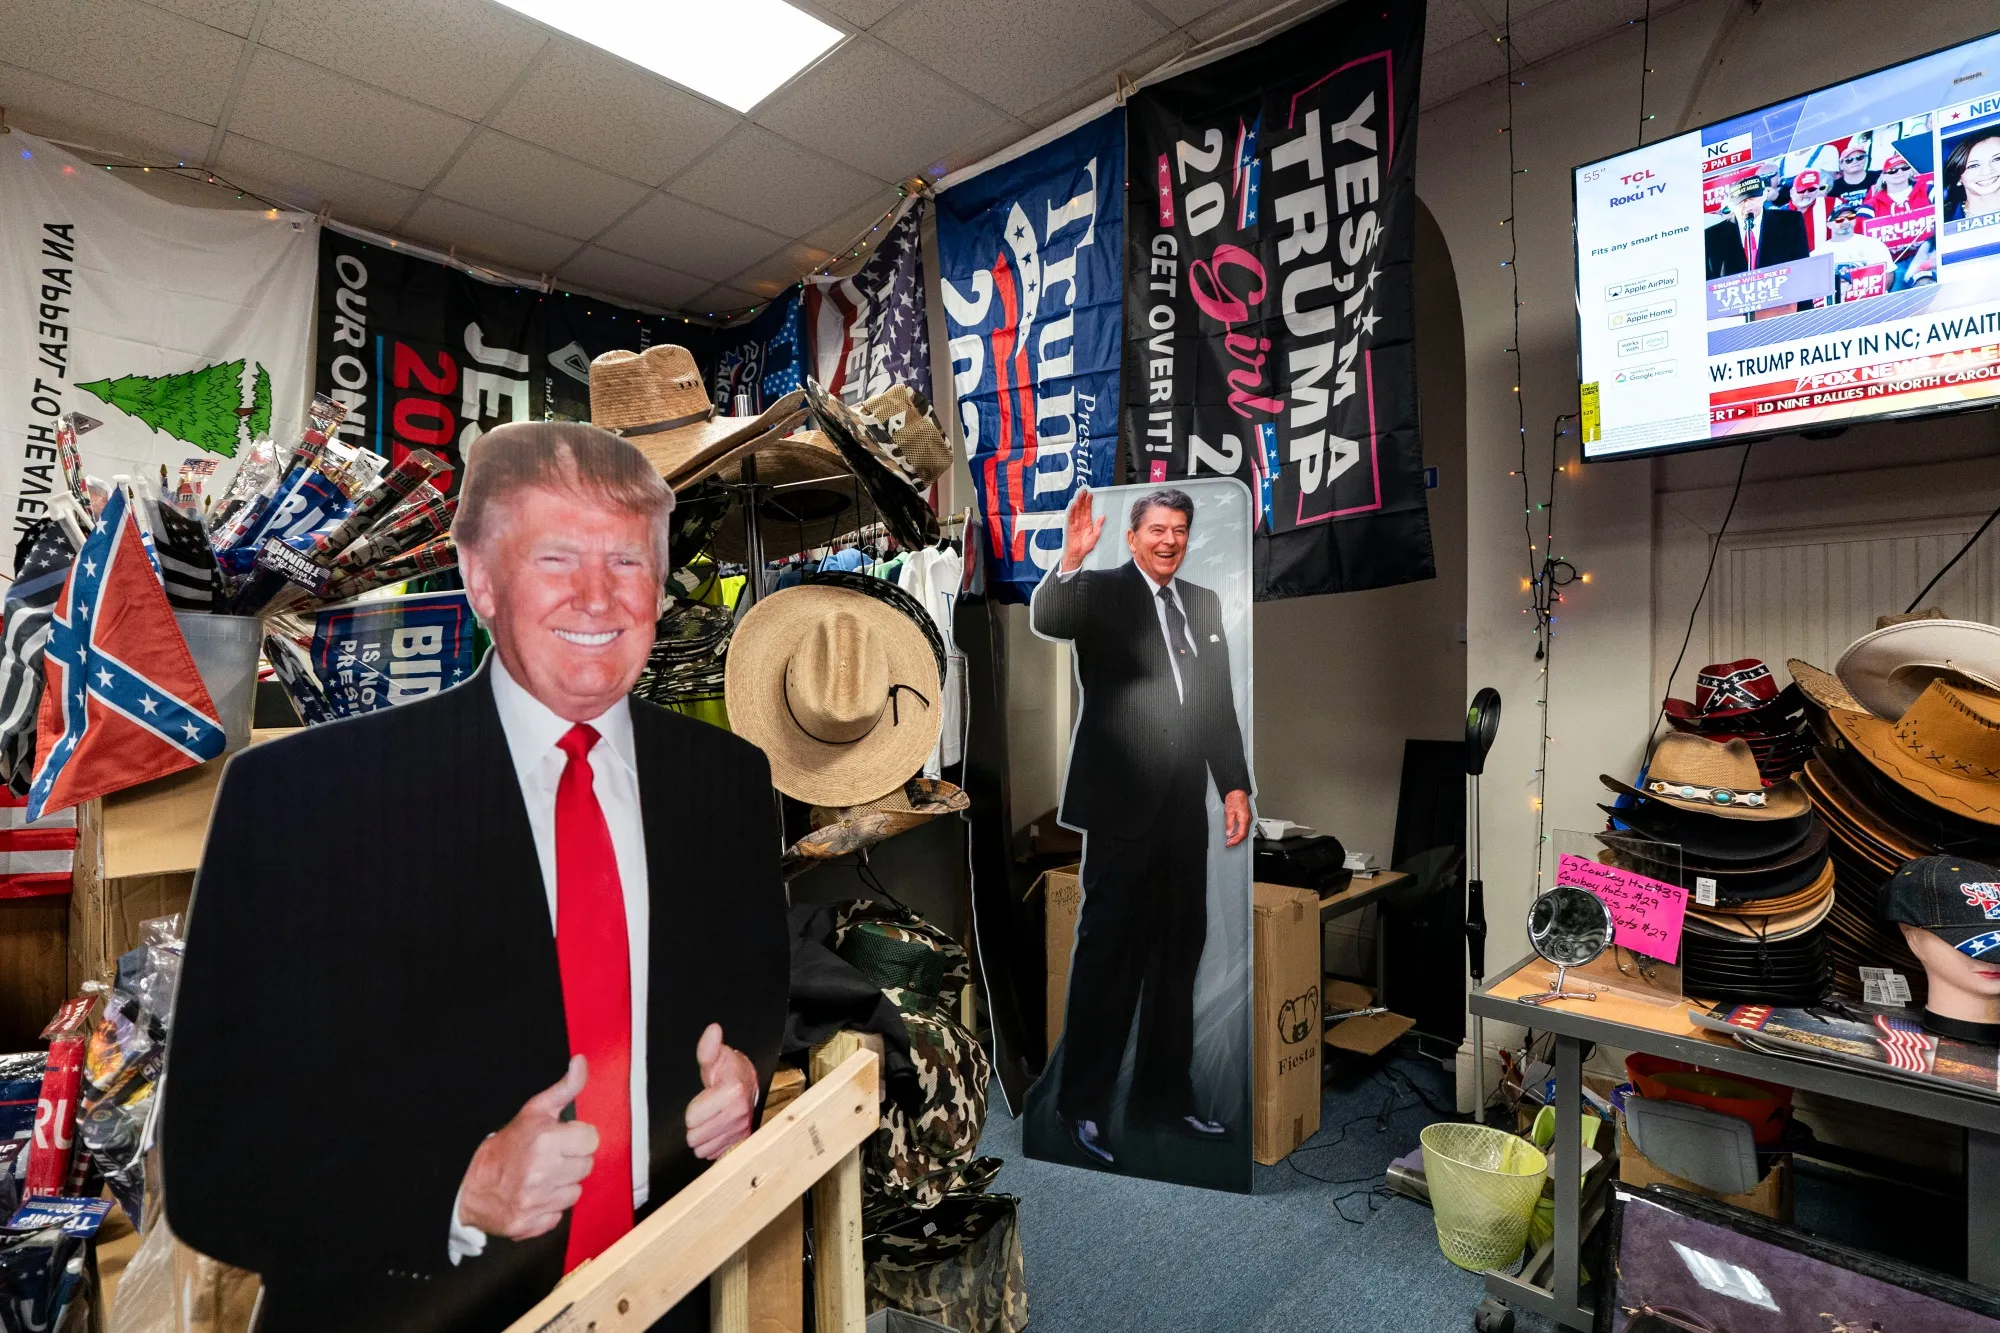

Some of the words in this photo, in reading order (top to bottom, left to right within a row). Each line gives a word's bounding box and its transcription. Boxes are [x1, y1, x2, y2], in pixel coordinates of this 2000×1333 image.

[1708, 142, 1728, 158] NC
[1711, 157, 1727, 169] PM
[1730, 152, 1743, 163] ET
[1584, 167, 1606, 183] 55"
[1620, 169, 1655, 186] TCL
[1647, 182, 1667, 196] TV
[1591, 247, 1608, 256] Fits
[1611, 241, 1627, 252] any
[1631, 233, 1658, 246] smart
[1661, 225, 1689, 238] home
[1868, 214, 1935, 237] TRUMP
[1151, 234, 1178, 298] GET
[1712, 280, 1741, 290] TRUMP
[1742, 274, 1763, 283] WILL
[1764, 271, 1778, 279] FIX
[333, 255, 368, 348] OUR
[1271, 108, 1338, 494] TRUMP
[1624, 285, 1646, 295] Apple
[1648, 277, 1675, 289] AirPlay
[1713, 276, 1789, 300] TRUMP
[1720, 288, 1780, 307] VANCE
[1626, 313, 1648, 324] Apple
[1650, 308, 1673, 319] Home
[1738, 304, 1763, 313] 2024
[1188, 243, 1285, 419] Girl
[1014, 156, 1097, 570] Trump
[1148, 304, 1176, 403] OVER
[1708, 364, 1732, 382] W:
[1737, 352, 1795, 377] TRUMP
[1800, 339, 1852, 366] RALLY
[1858, 334, 1879, 356] IN
[1885, 328, 1921, 351] NC;
[1629, 373, 1653, 382] Google
[1654, 369, 1674, 377] Home
[1811, 368, 1857, 390] FOX
[1863, 356, 1932, 383] NEWS
[1777, 396, 1811, 412] NINE
[1867, 383, 1884, 396] IN
[1888, 374, 1941, 394] NORTH
[1145, 410, 1172, 453] IT!
[1327, 433, 1359, 487] A
[362, 643, 381, 662] IS
[387, 625, 444, 706] BID
[337, 640, 360, 717] PRESI
[1558, 871, 1599, 892] Cowboy
[1601, 884, 1628, 899] Hats
[1632, 892, 1659, 910] $29
[1562, 857, 1578, 872] Lg
[1580, 863, 1625, 887] Cowboy
[1628, 878, 1654, 892] Hat
[1655, 884, 1682, 904] $39
[1642, 923, 1668, 941] $29
[1277, 1046, 1316, 1077] Fiesta
